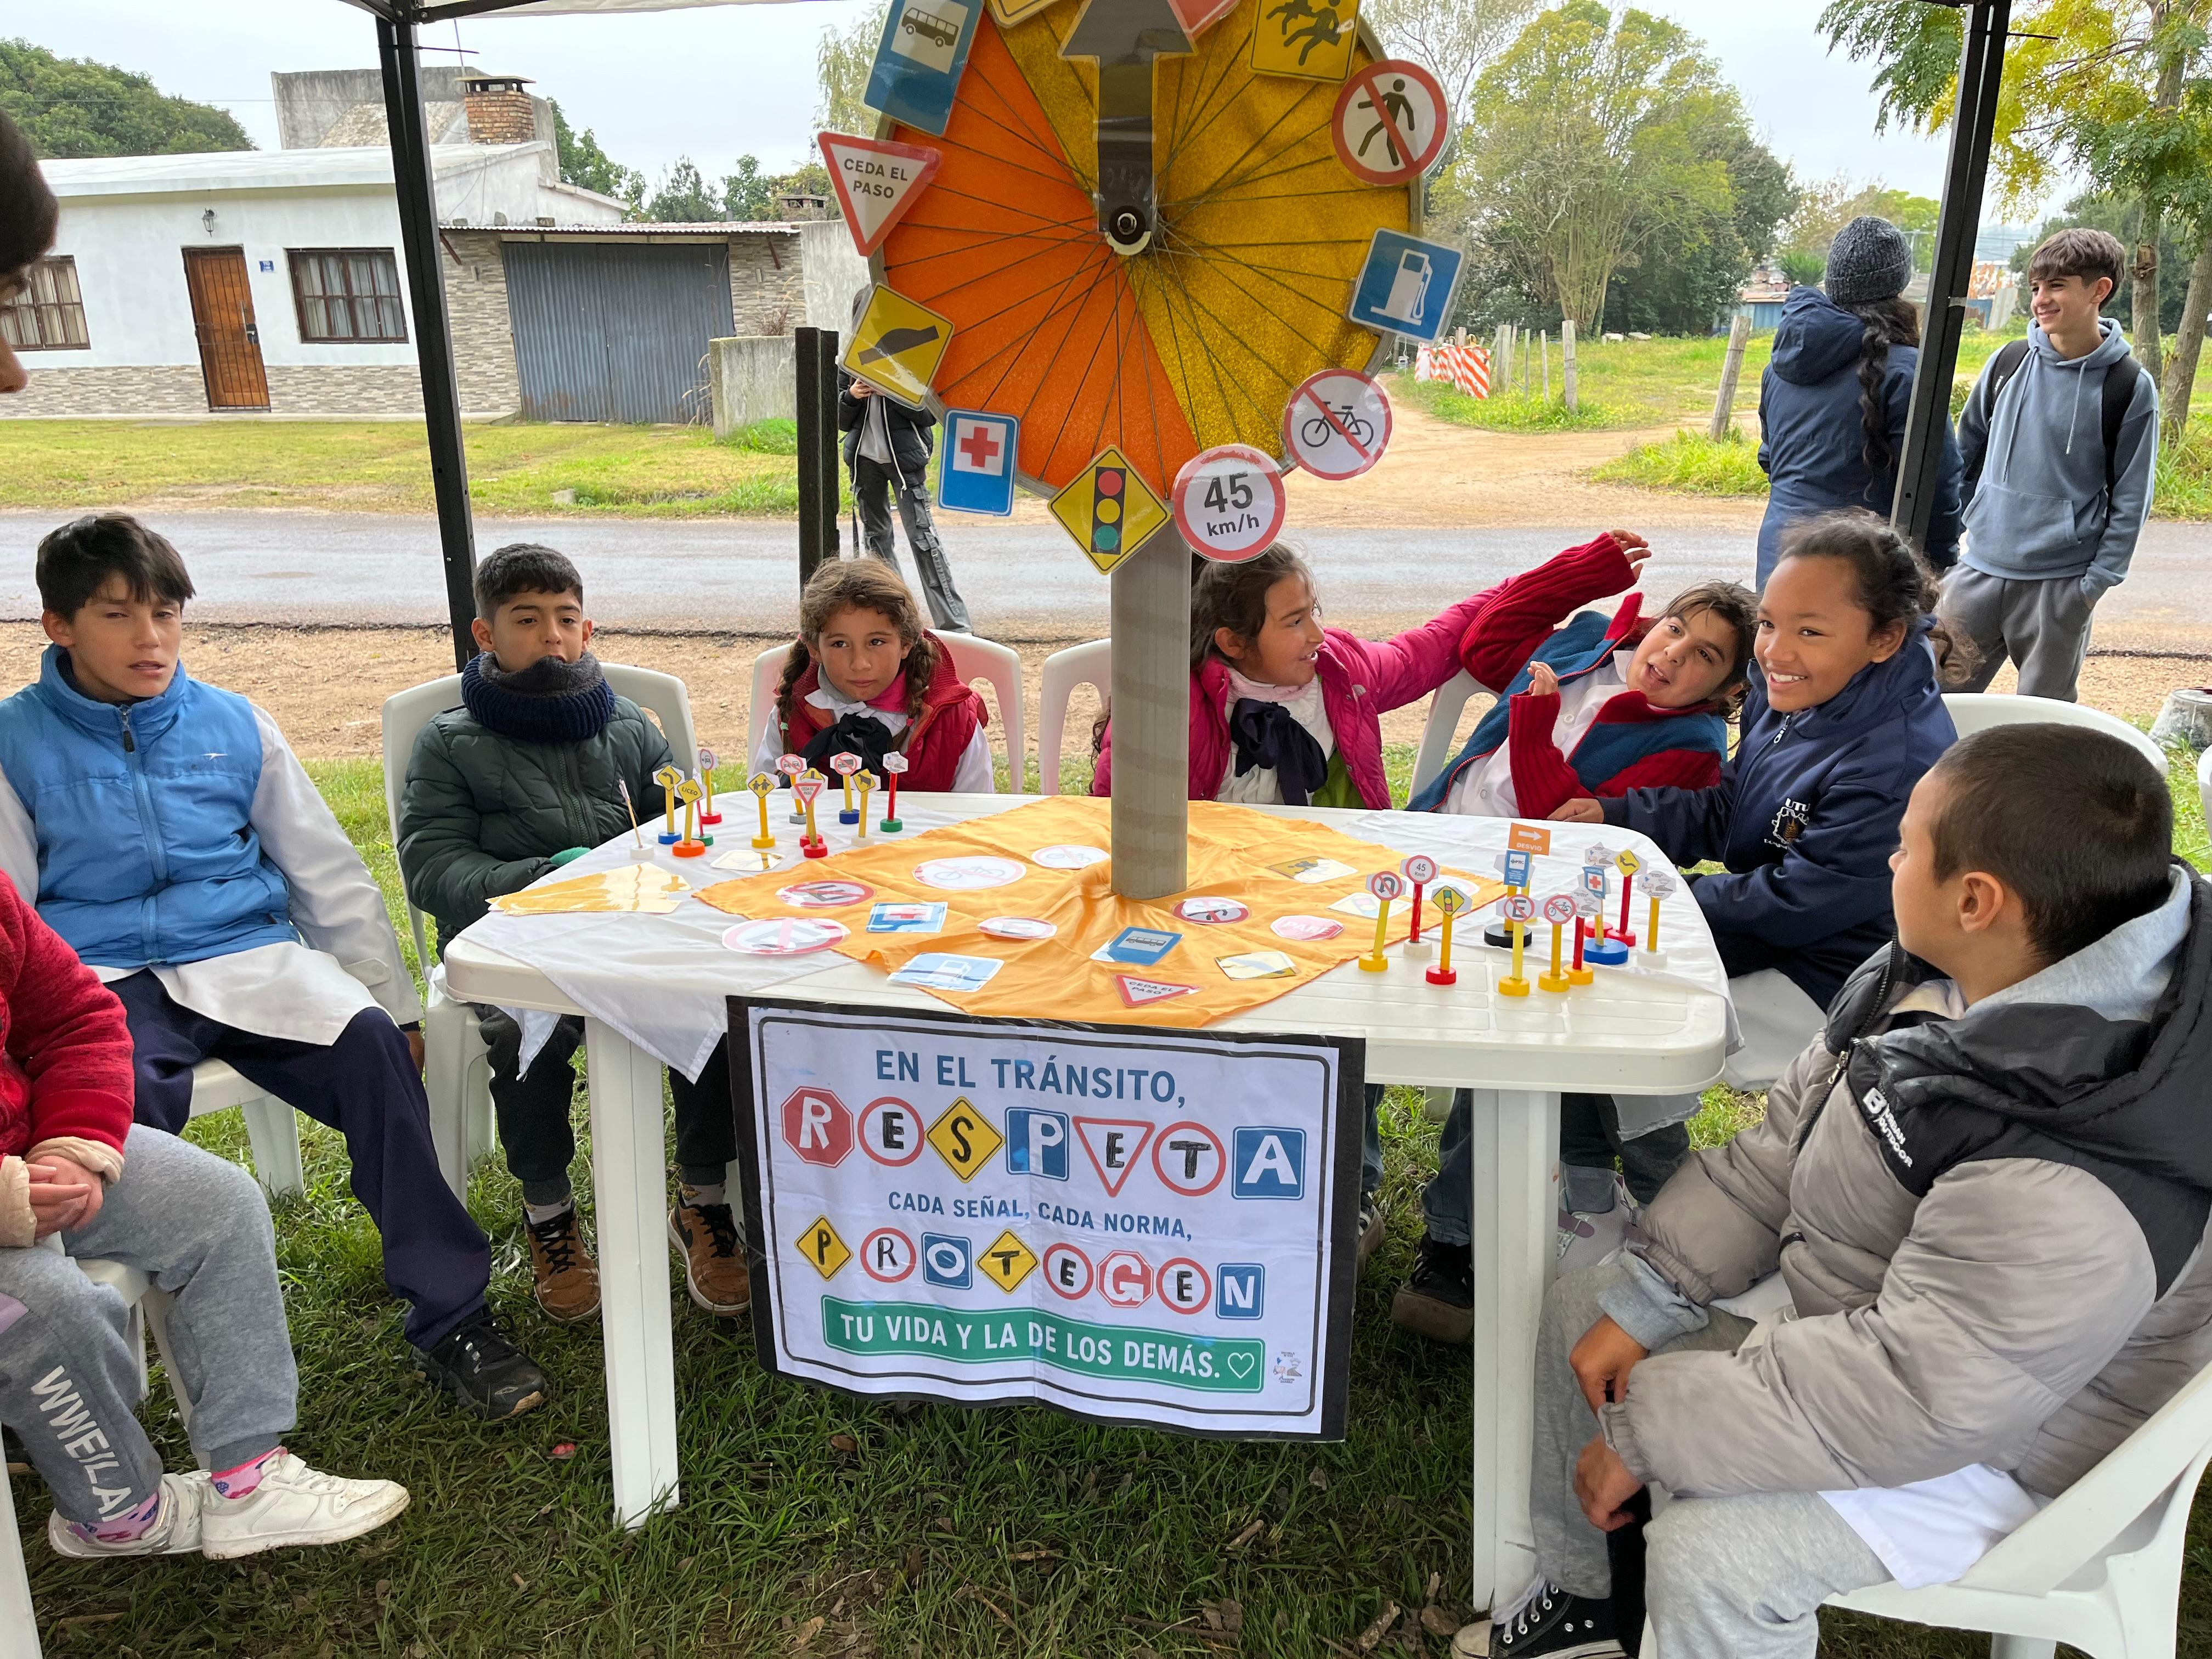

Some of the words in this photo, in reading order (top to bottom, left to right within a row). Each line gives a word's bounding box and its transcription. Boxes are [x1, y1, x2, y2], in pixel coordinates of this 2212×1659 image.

[844, 158, 885, 177] CEDA
[890, 166, 908, 182] EL
[853, 180, 894, 199] PASO
[1204, 471, 1253, 513] 45
[1206, 514, 1260, 537] km/h
[1516, 842, 1542, 851] DESVIO
[1416, 863, 1426, 872] 45
[1129, 981, 1158, 990] CEDA
[1131, 986, 1162, 995] PASO
[876, 1049, 919, 1082] EN
[936, 1055, 976, 1088] EL
[991, 1054, 1186, 1109] TRÁNSITO,
[1884, 1108, 1906, 1145] URBAN
[1878, 1117, 1913, 1168] OUTDOOR
[888, 1191, 945, 1215] CADA
[953, 1195, 1030, 1220] SEÑAL,
[1038, 1201, 1094, 1229] CADA
[1104, 1212, 1192, 1242] NORMA,
[840, 1313, 874, 1342] TU
[885, 1315, 947, 1347] VIDA
[956, 1324, 973, 1350] Y
[984, 1322, 1018, 1349] LA
[1028, 1321, 1057, 1353] DE
[1066, 1332, 1112, 1365] LOS
[1124, 1341, 1220, 1378] DEMÁS.
